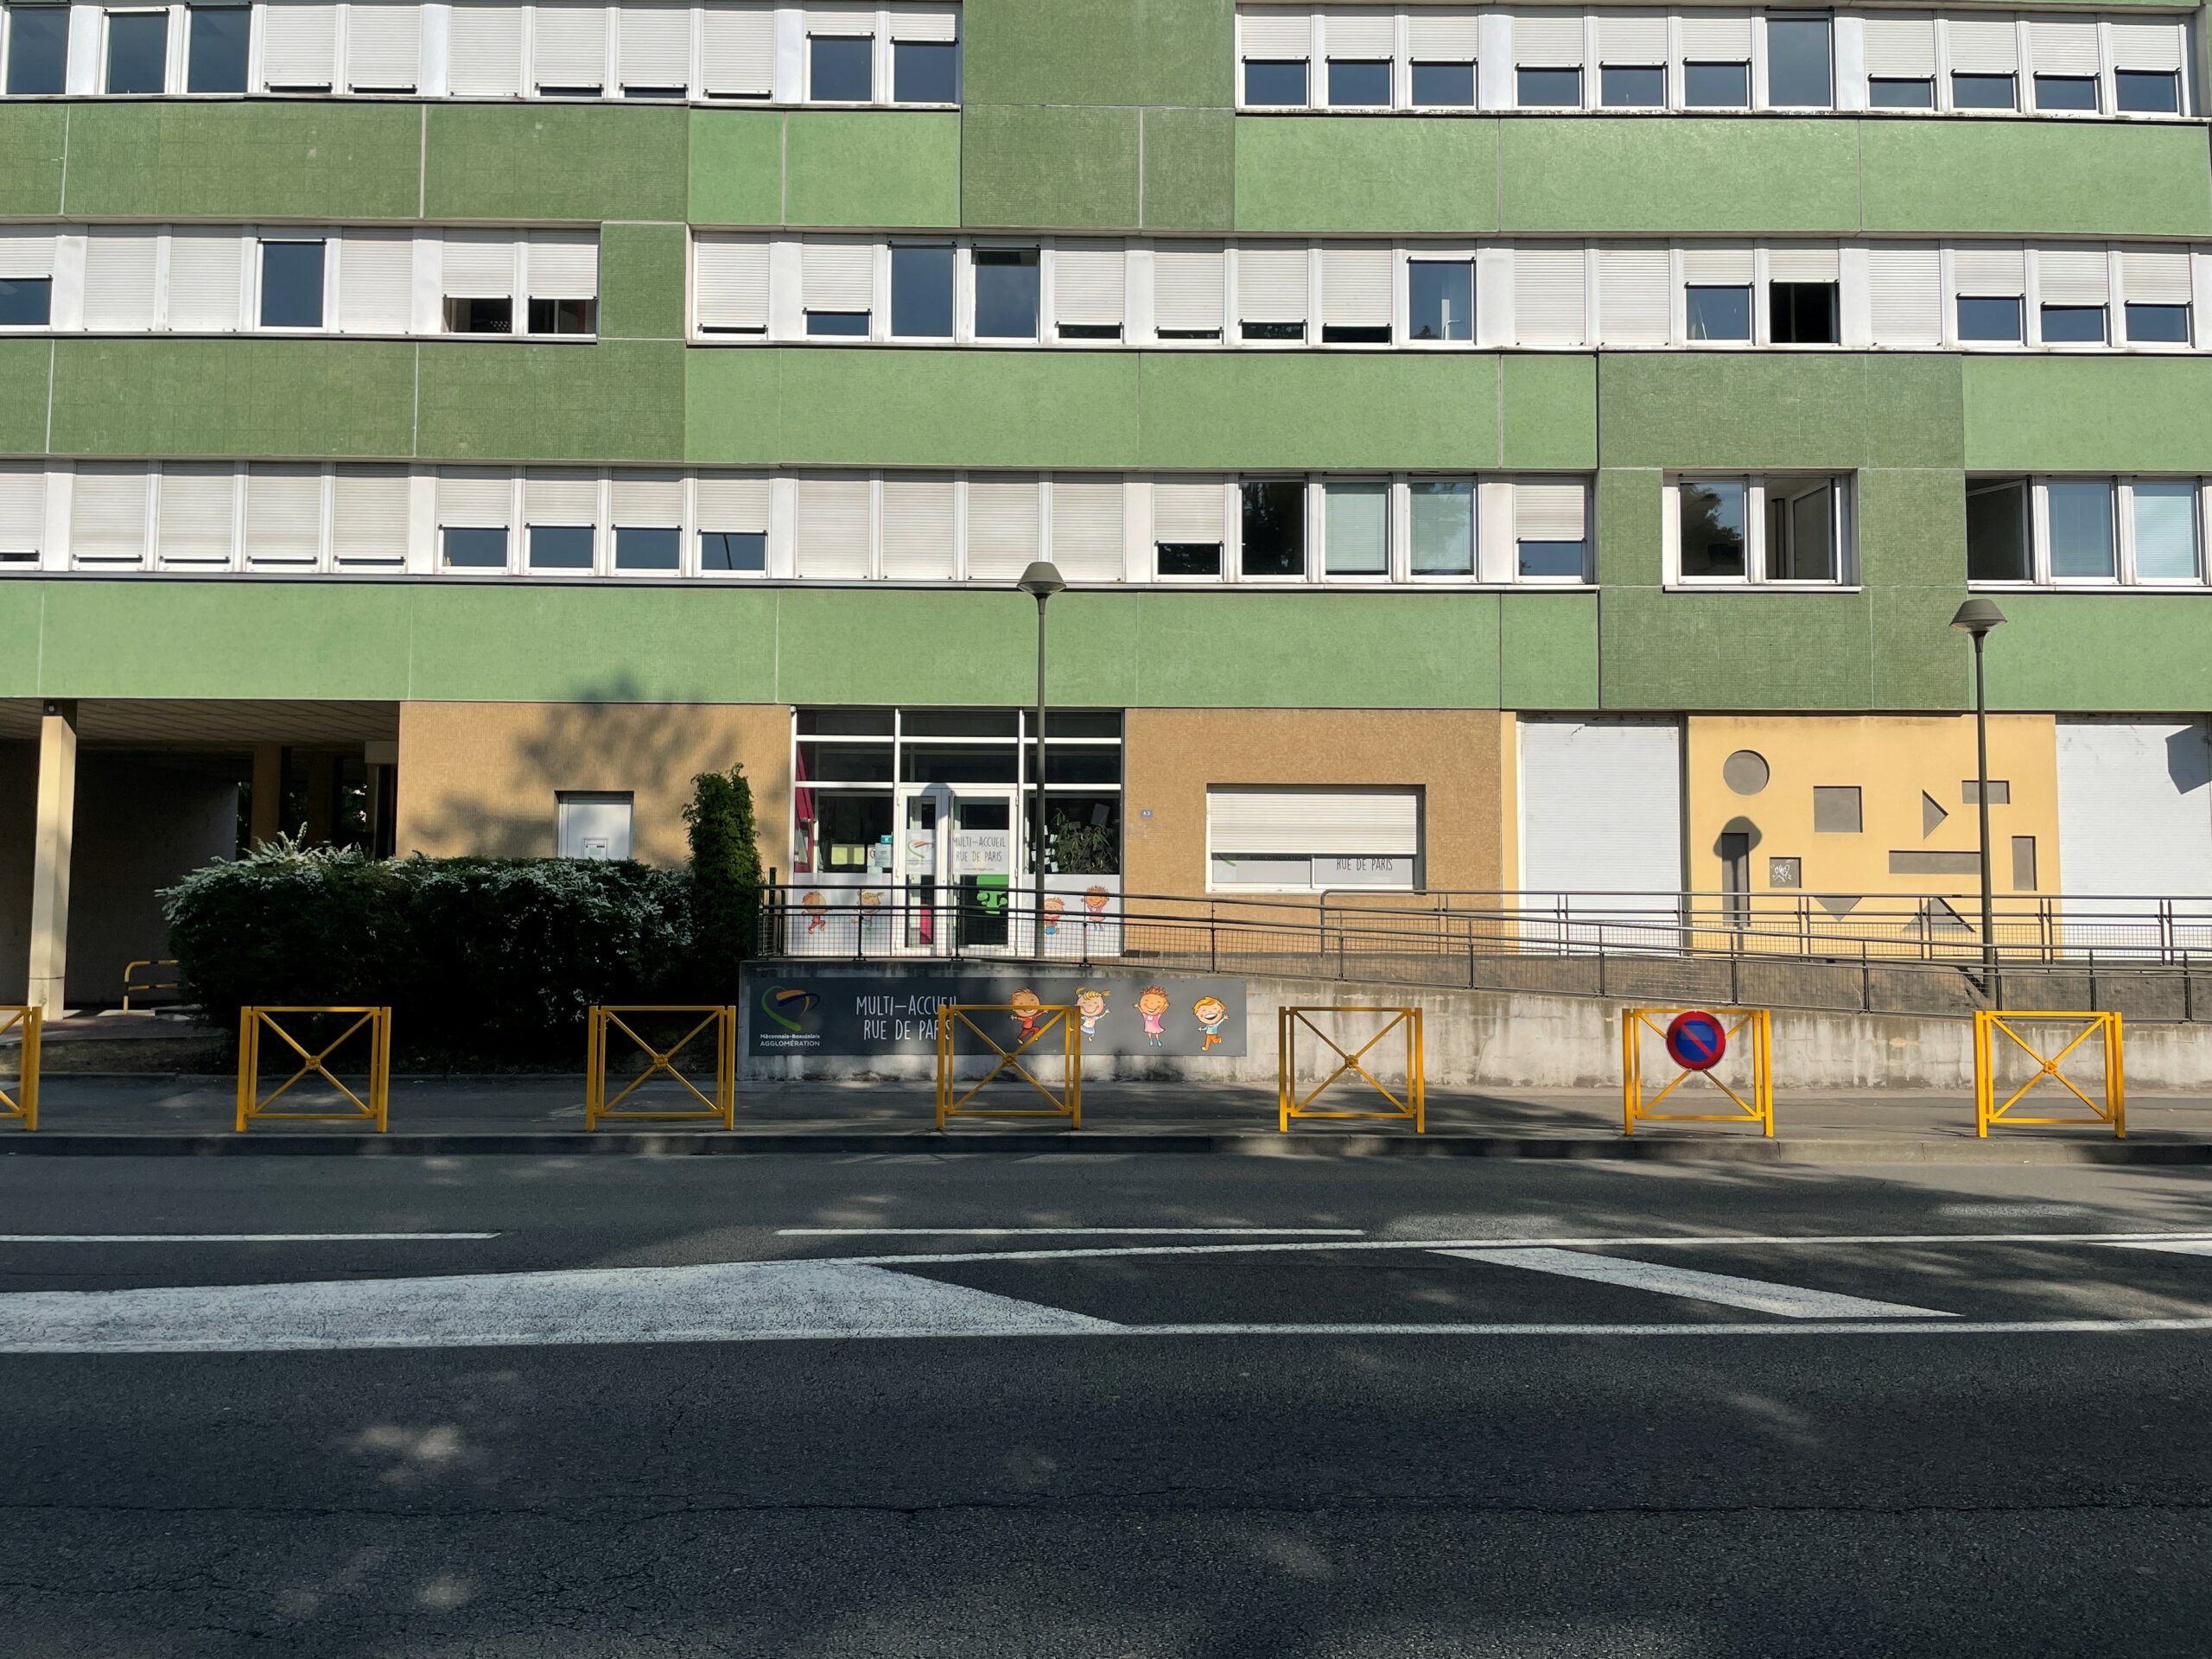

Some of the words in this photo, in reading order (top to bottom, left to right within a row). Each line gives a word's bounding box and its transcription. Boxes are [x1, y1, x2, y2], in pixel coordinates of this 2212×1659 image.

[952, 836, 1007, 848] MULTI-ACCUEIL
[956, 851, 968, 862] RUE
[972, 851, 981, 862] DE
[984, 851, 1002, 862] PARIS
[1336, 857, 1351, 870] RUE
[1357, 857, 1366, 870] DE
[1371, 857, 1393, 871] PARIS
[864, 1020, 887, 1040] RUE
[895, 1020, 911, 1040] DE
[918, 1019, 950, 1040] PARS
